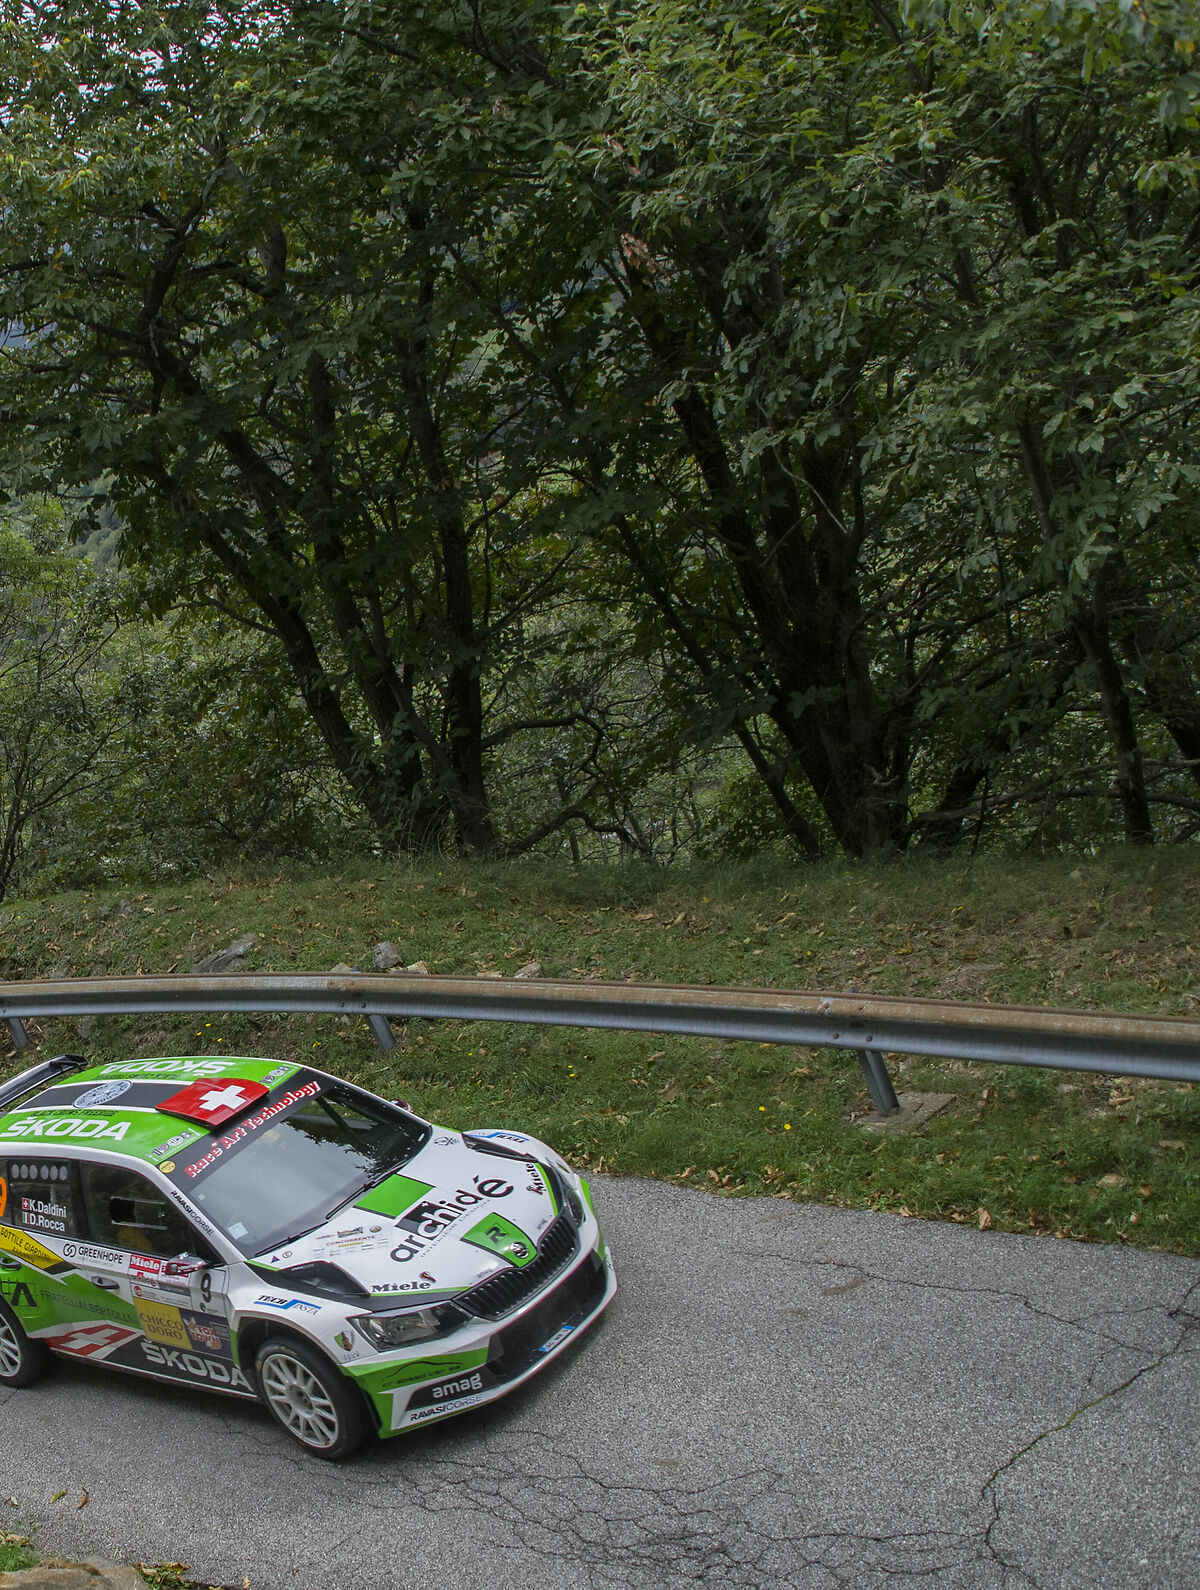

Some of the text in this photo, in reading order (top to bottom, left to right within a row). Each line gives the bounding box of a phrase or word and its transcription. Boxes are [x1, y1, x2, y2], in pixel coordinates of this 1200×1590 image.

[100, 1060, 236, 1077] ŠKODA
[0, 1115, 132, 1141] ŠKODA
[184, 1147, 224, 1178] Race
[220, 1126, 248, 1150] Art
[241, 1080, 322, 1130] Technology
[29, 1199, 67, 1218] K.Daldini
[29, 1213, 65, 1231] D.Rocca
[390, 1175, 514, 1262] archidé
[78, 1246, 124, 1264] GREENHOPE
[130, 1256, 160, 1270] Miele
[200, 1272, 212, 1303] 9
[371, 1281, 431, 1292] Miele
[258, 1295, 288, 1305] TECH
[140, 1312, 184, 1331] CHICCO
[140, 1338, 255, 1392] ŠKODA
[432, 1372, 484, 1399] amag
[410, 1396, 483, 1422] RAVASICORSE
